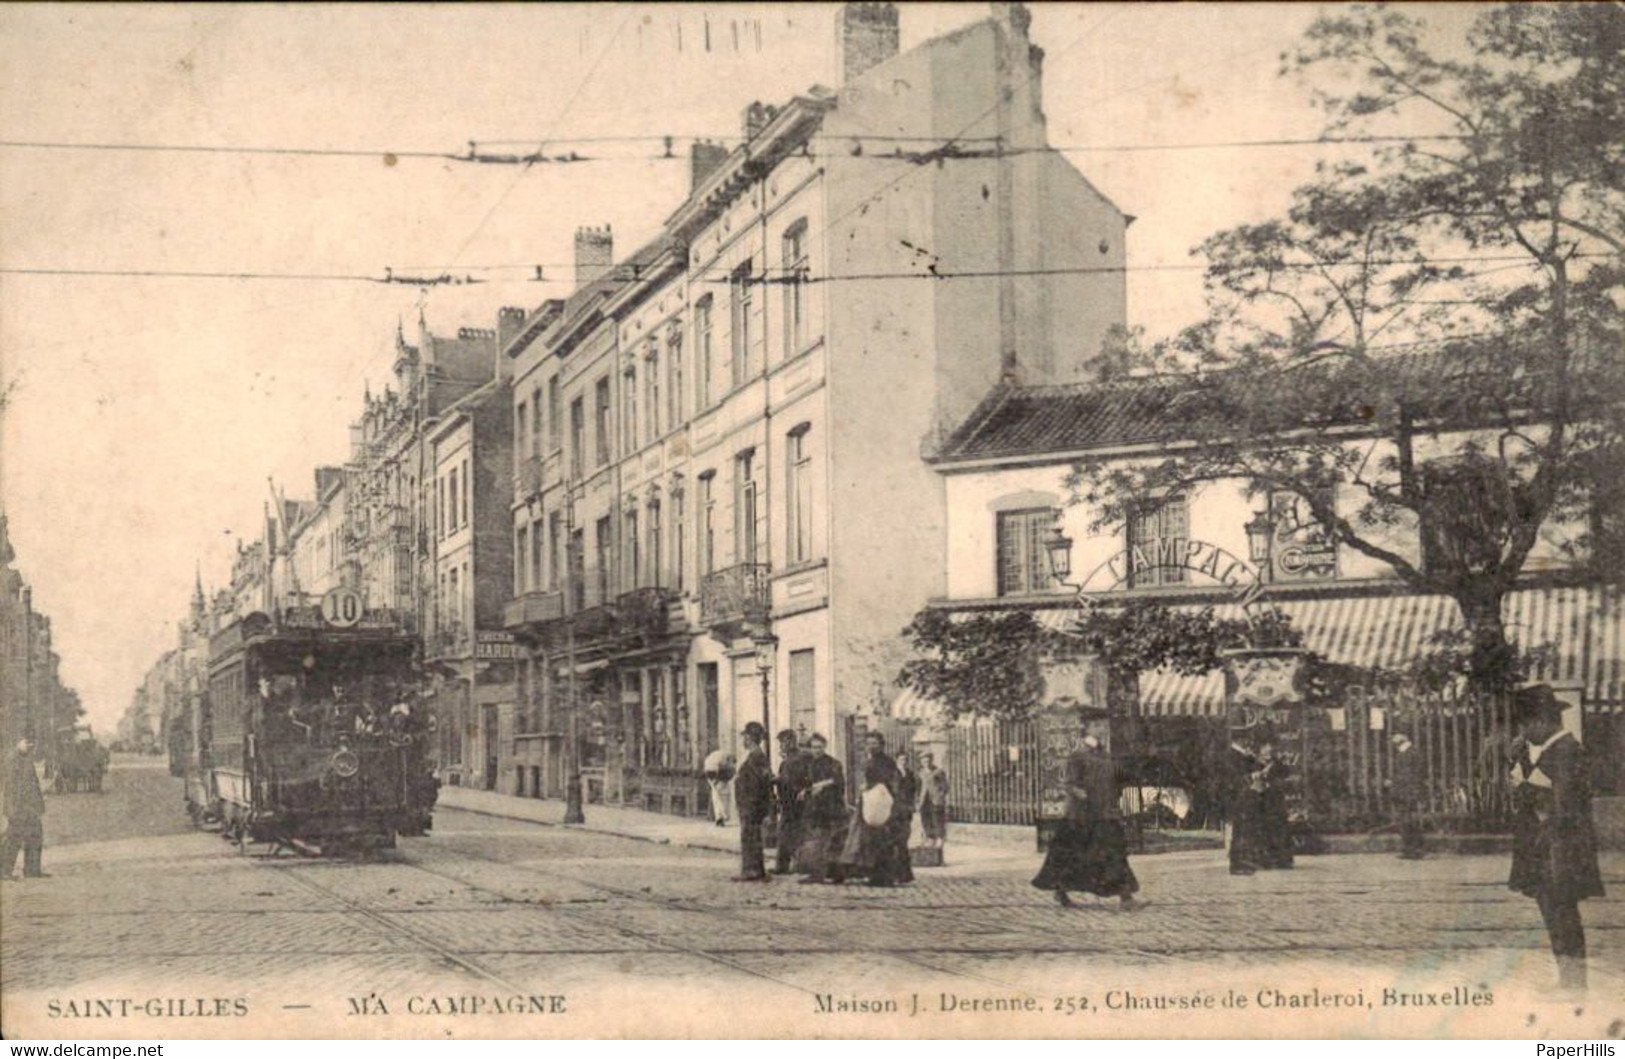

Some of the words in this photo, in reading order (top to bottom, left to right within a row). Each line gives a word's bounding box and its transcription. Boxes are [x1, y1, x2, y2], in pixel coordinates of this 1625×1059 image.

[329, 593, 356, 622] 10
[47, 998, 249, 1018] SAINT-GILLES
[347, 996, 390, 1016] MA
[407, 995, 568, 1016] CAMPAGNE
[813, 994, 898, 1013] Maison
[909, 993, 927, 1017] J.
[1053, 997, 1098, 1016] 252,
[1105, 991, 1215, 1010] Chaussée
[1221, 989, 1248, 1009] de
[1256, 988, 1373, 1011] Charleroi,
[1382, 984, 1495, 1007] Bruxelles
